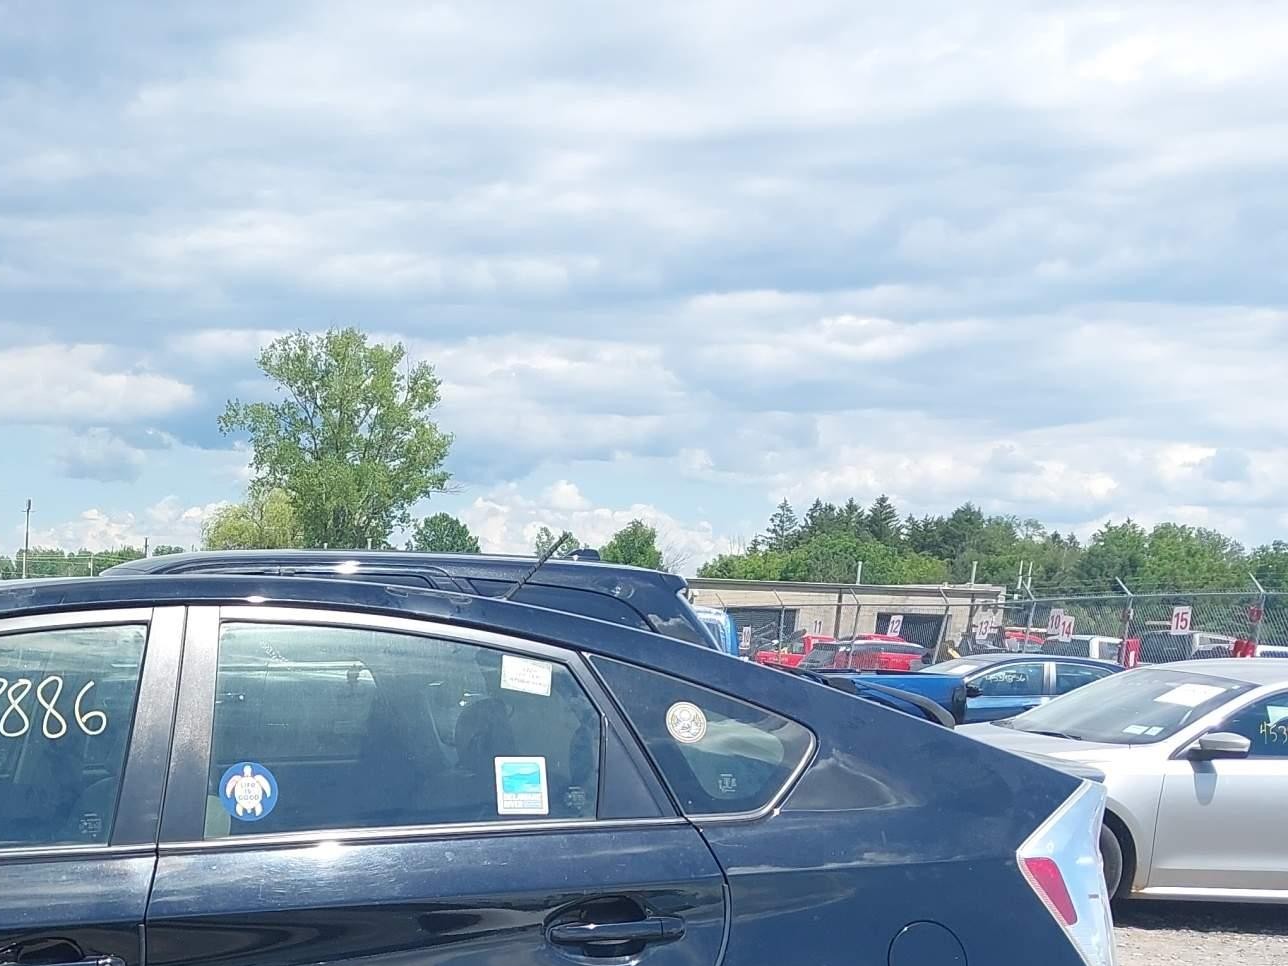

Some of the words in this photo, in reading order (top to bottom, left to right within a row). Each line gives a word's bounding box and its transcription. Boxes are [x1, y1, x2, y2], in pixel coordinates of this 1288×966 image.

[814, 620, 823, 634] 11
[889, 619, 902, 634] 12
[977, 620, 990, 637] 13
[1050, 614, 1061, 630] 10
[1173, 611, 1190, 630] 15
[1061, 621, 1072, 638] 14
